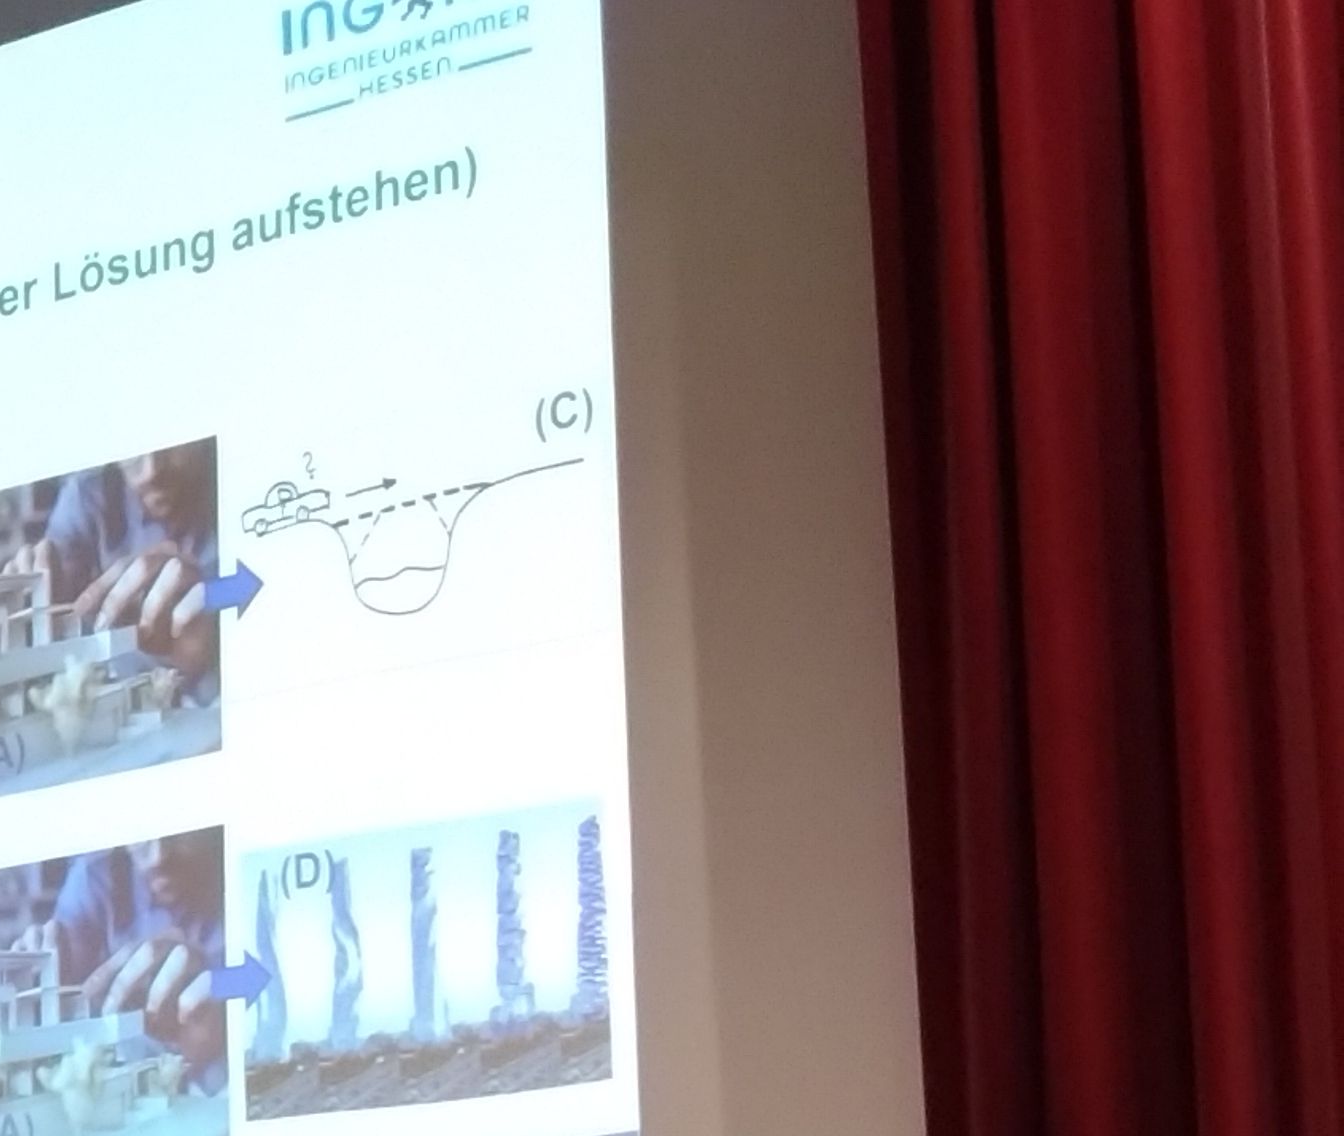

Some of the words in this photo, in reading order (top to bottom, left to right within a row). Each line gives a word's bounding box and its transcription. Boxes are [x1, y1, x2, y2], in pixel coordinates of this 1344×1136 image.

[284, 4, 530, 94] INGENIEURKAMMER
[358, 56, 452, 99] HESSEN
[54, 226, 216, 303] Lösung
[230, 146, 479, 252] aufstehen)
[534, 387, 594, 442] (C)
[280, 848, 334, 898] (D)
